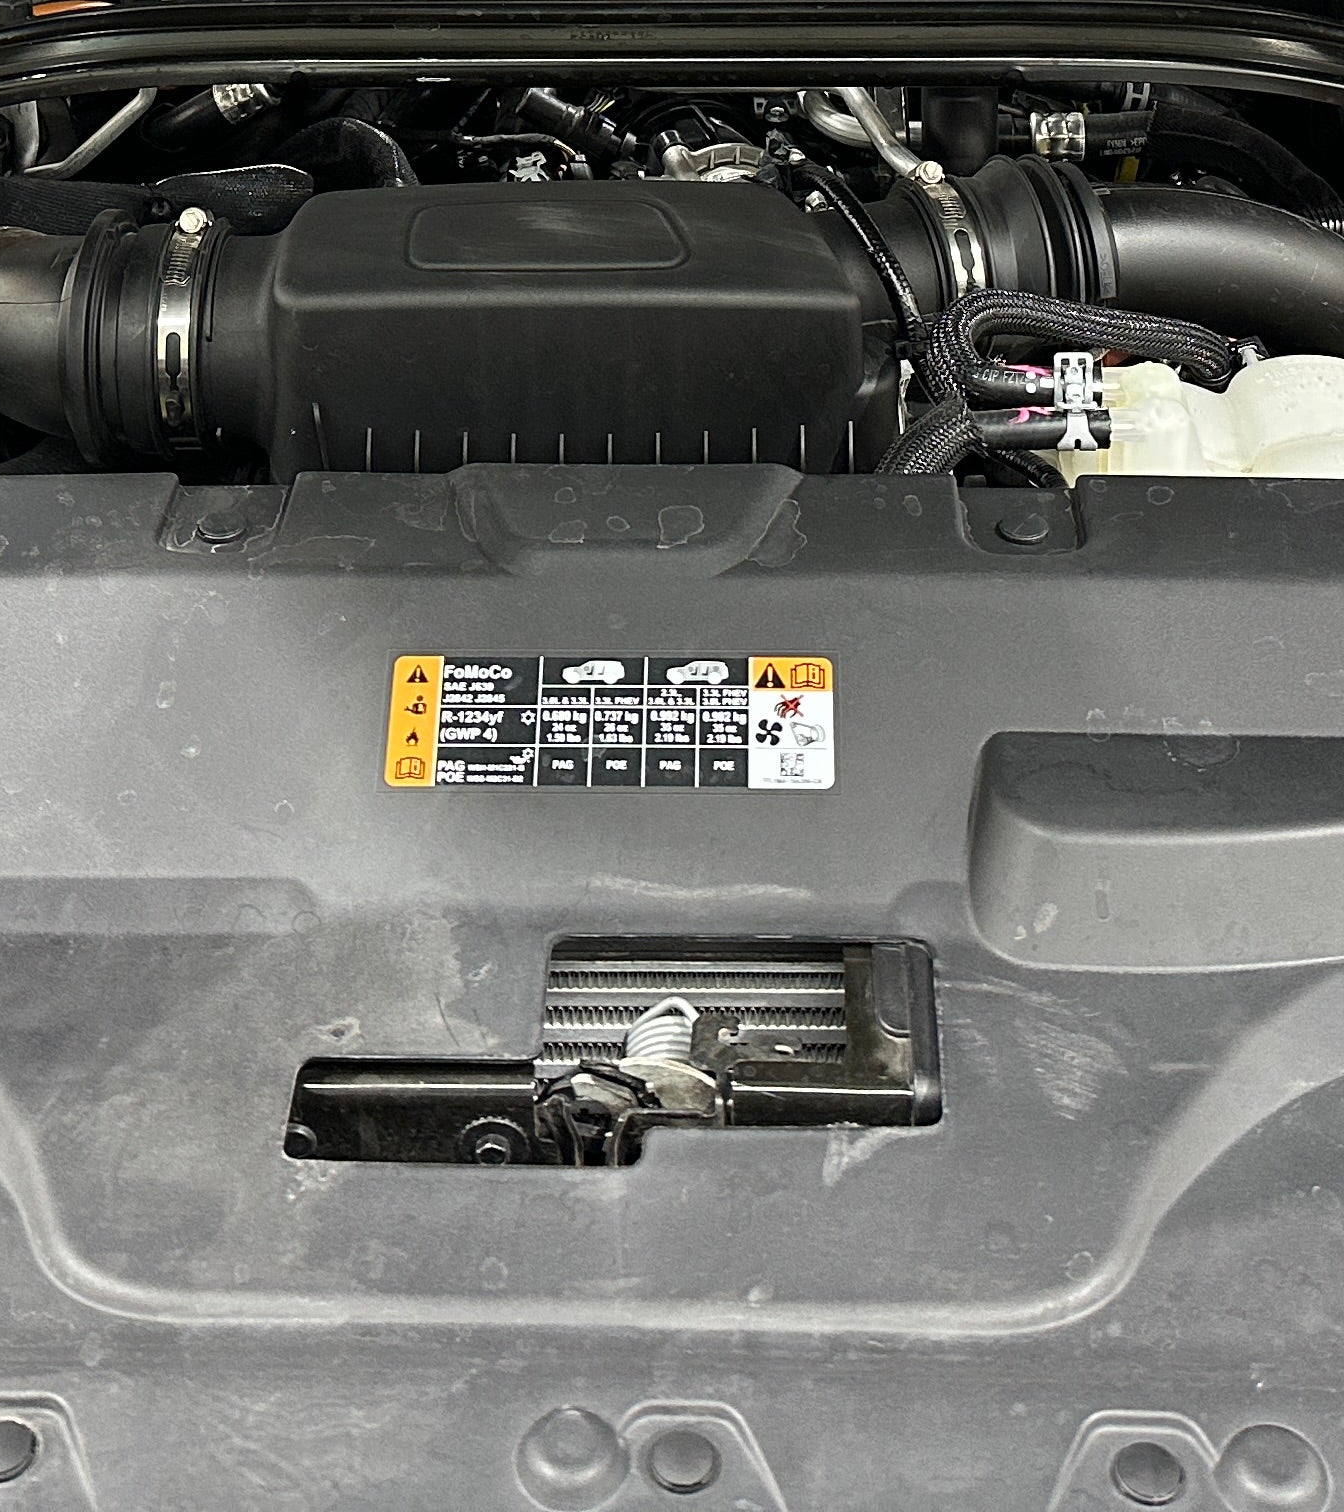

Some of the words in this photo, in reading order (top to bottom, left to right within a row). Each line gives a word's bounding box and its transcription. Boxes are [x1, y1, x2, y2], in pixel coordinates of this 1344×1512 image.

[444, 665, 513, 679] FoMoCo
[443, 682, 467, 691] SAE
[441, 710, 504, 726] R-1234yf
[572, 710, 587, 724] kg
[594, 710, 623, 721] 0.737
[624, 710, 639, 724] kg
[680, 710, 695, 724] kg
[732, 711, 747, 725] kg
[440, 727, 482, 742] (GWP
[482, 727, 498, 742] 4)
[437, 760, 466, 772] PAG
[551, 759, 575, 770] PAG
[605, 759, 628, 770] POE
[659, 760, 682, 771] PAG
[713, 760, 735, 771] POE
[436, 771, 466, 783] POE
